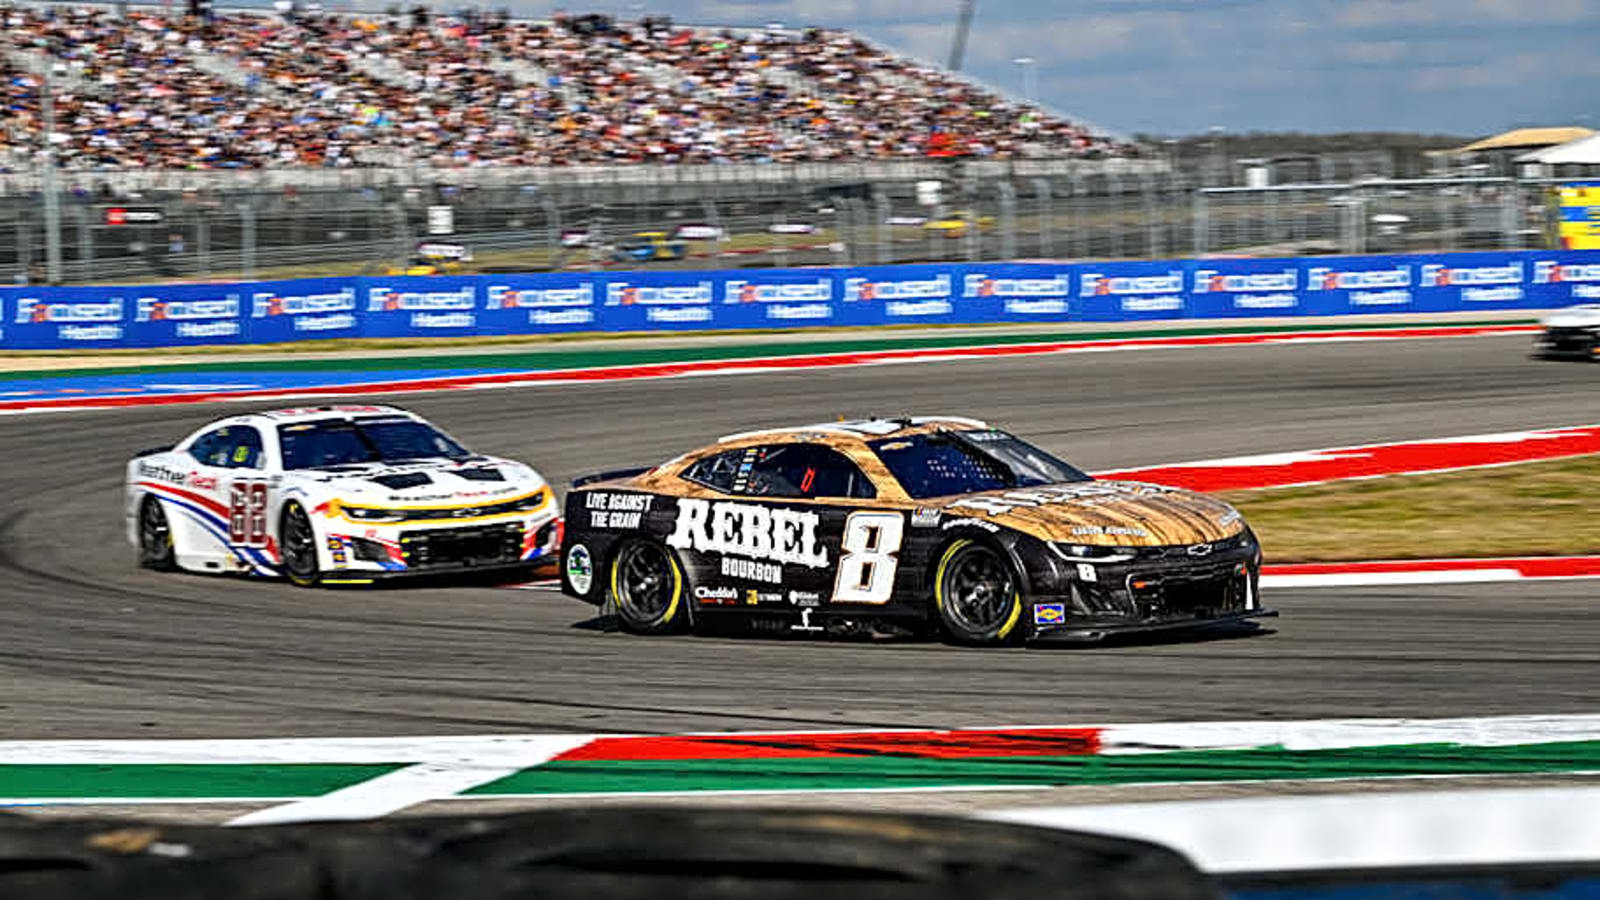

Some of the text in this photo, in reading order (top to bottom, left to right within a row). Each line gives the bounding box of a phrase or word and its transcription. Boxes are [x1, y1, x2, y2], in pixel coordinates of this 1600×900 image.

[585, 492, 654, 512] LIVE AGAINST
[591, 511, 641, 529] THE GRAIN
[665, 498, 831, 568] REBEL
[830, 510, 905, 605] 8
[721, 557, 782, 584] BOURBON
[1076, 563, 1097, 582] 8
